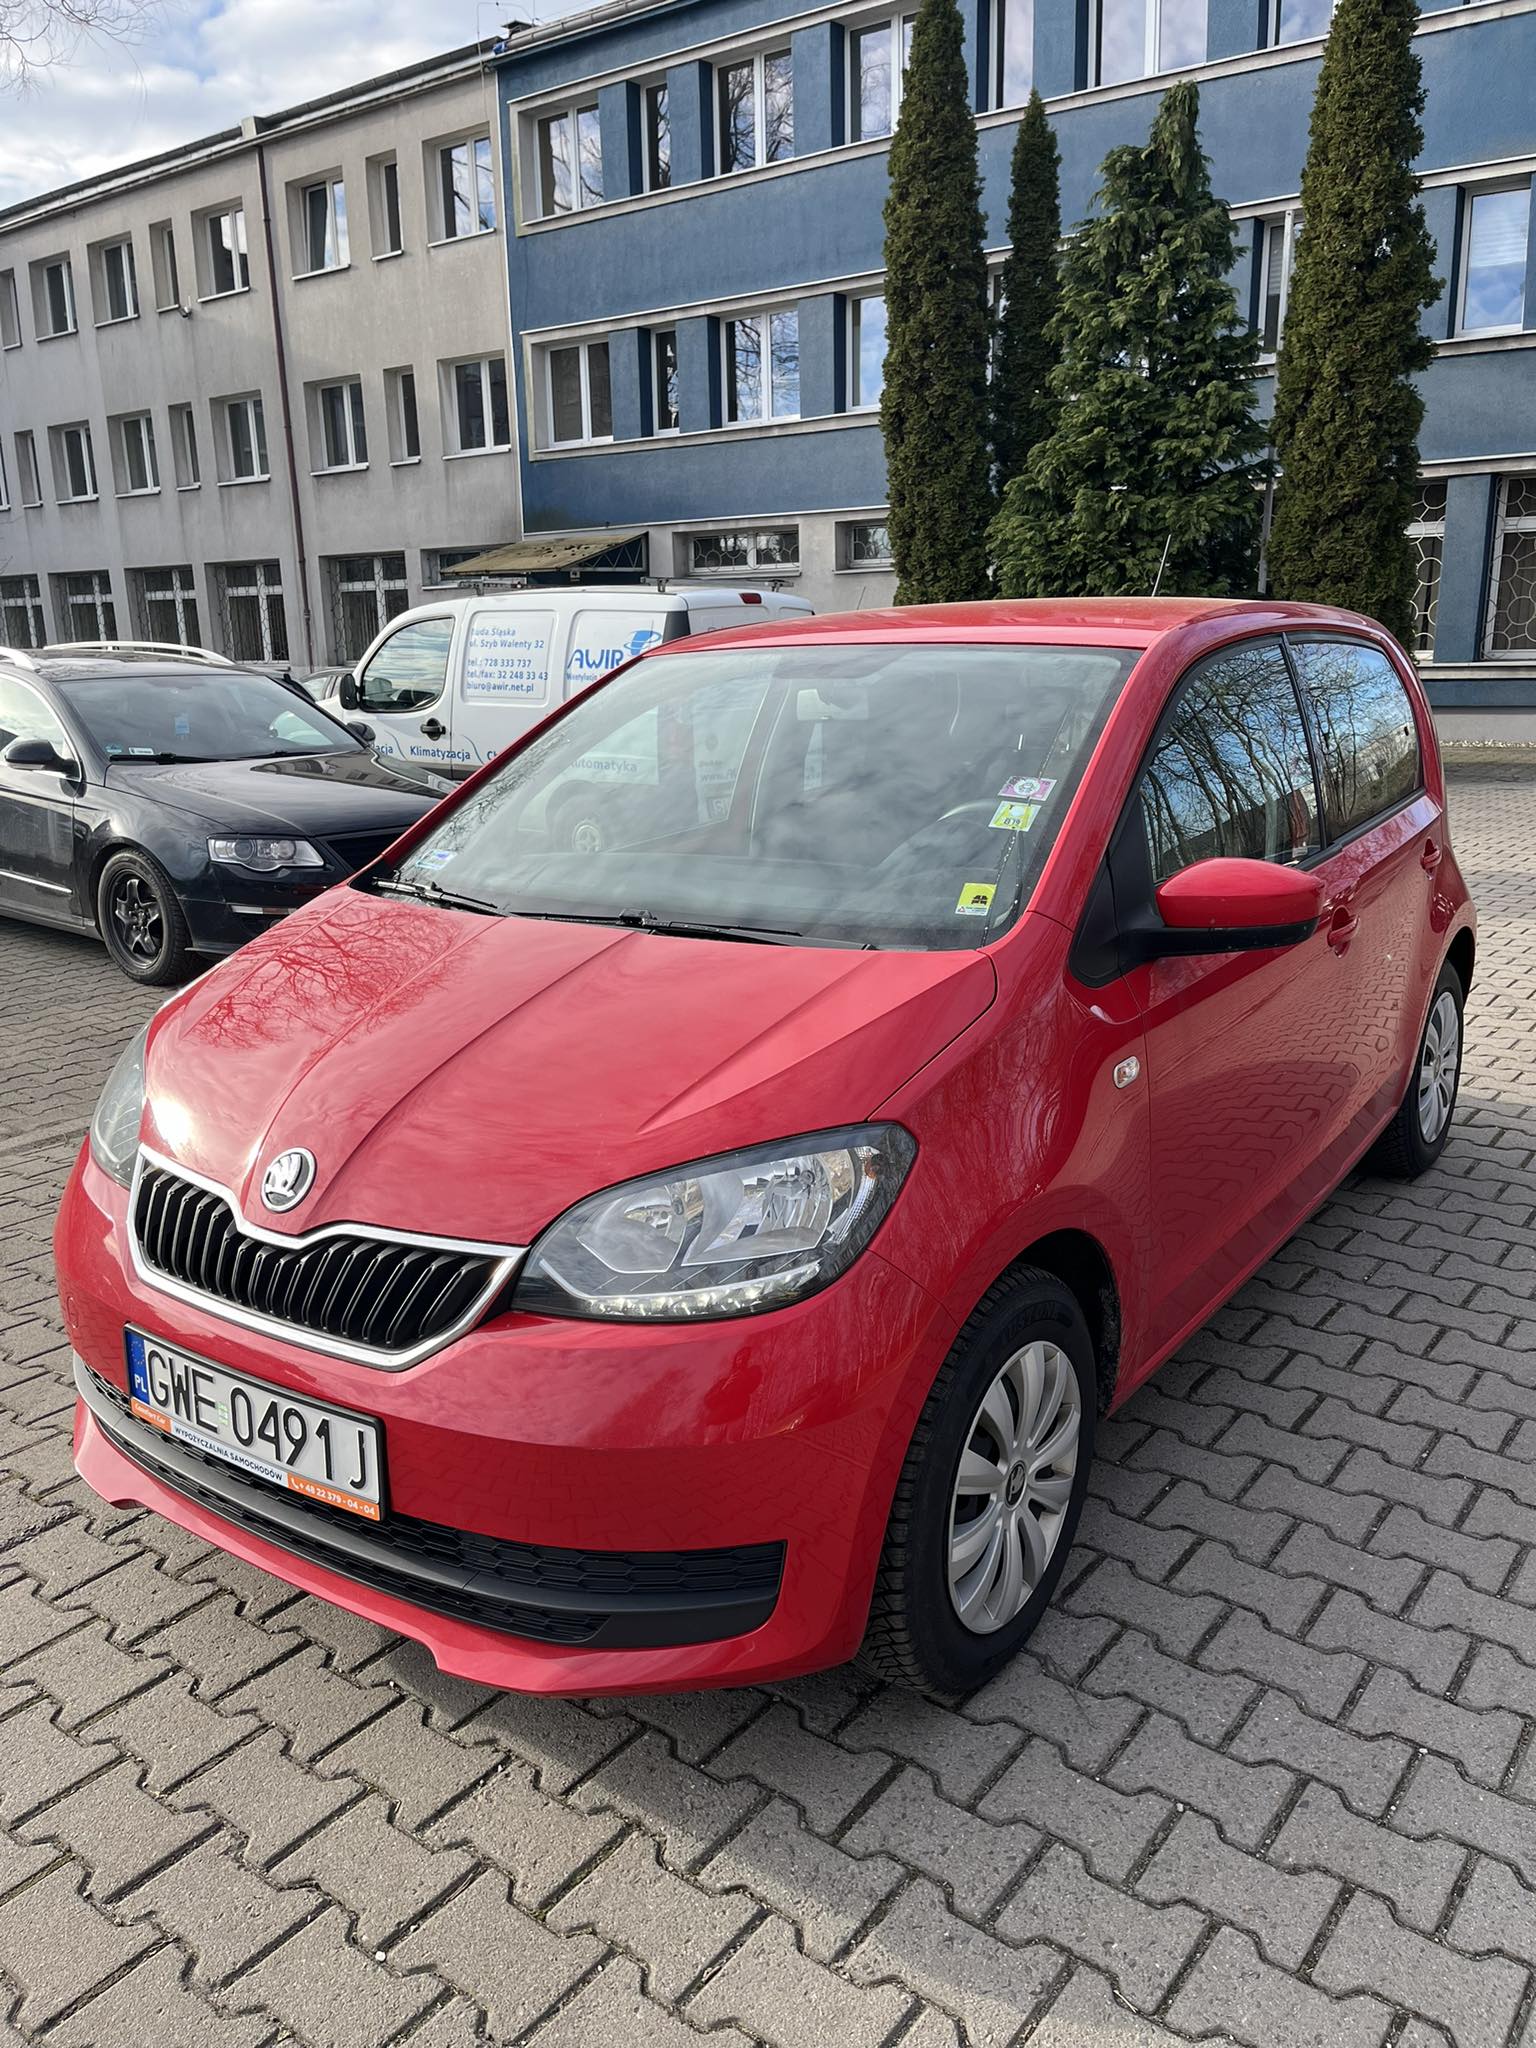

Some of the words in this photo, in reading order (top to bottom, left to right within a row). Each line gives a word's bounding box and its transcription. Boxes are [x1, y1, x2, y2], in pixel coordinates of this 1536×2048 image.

[480, 639, 498, 650] Szyb
[499, 639, 532, 650] Walenty
[534, 640, 545, 649] 32
[484, 658, 498, 667] 728
[500, 658, 514, 668] 333
[517, 659, 532, 668] 737
[567, 648, 624, 670] AWIR
[497, 670, 507, 679] 32
[509, 670, 524, 680] 248
[526, 671, 536, 681] 33
[538, 671, 549, 681] 43
[466, 681, 534, 693] biuro@awir.net.pl
[410, 745, 471, 761] Klimatyzacja
[134, 1373, 147, 1393] PL
[147, 1349, 219, 1434] GWE
[230, 1452, 283, 1481] SAMOCHODÓW
[316, 1488, 326, 1499] 22
